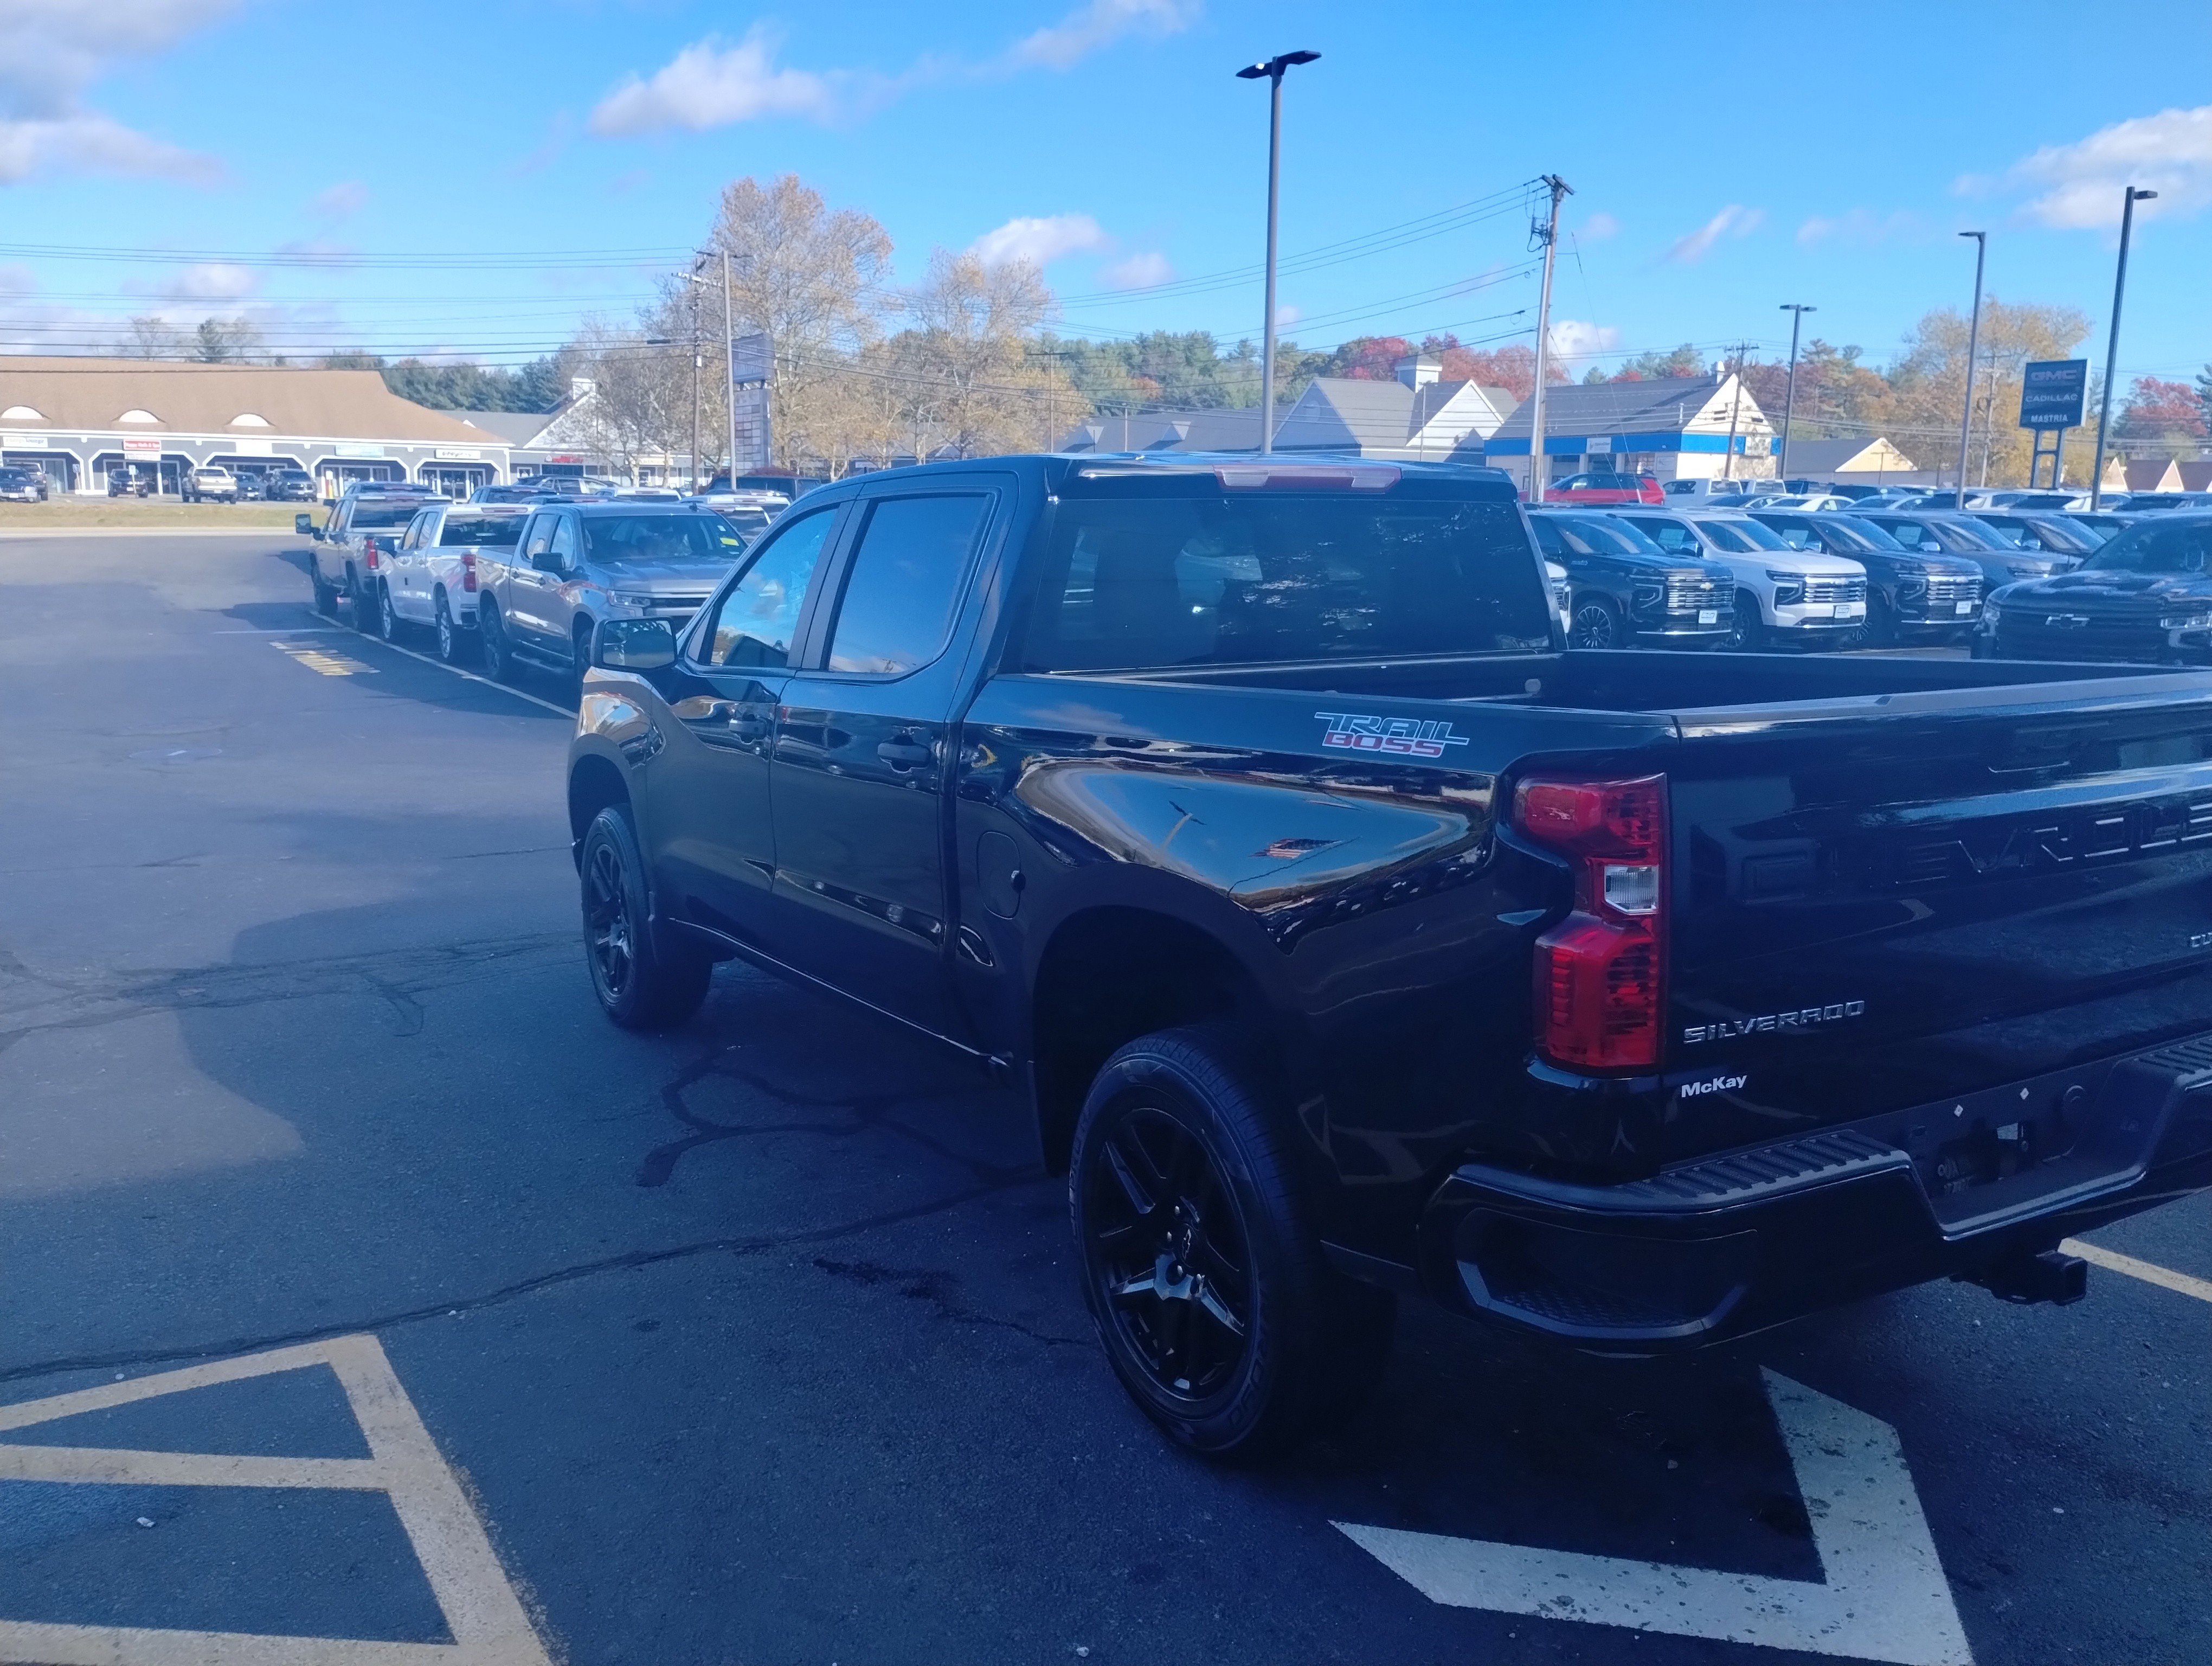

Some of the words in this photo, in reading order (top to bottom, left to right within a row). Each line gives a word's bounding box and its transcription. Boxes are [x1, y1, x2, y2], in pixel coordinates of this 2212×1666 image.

[2031, 370, 2077, 381] GMC
[2025, 393, 2078, 402] CADILLAC
[2030, 414, 2068, 423] MASTRIA
[1314, 712, 1470, 746] TRAIL
[1322, 731, 1446, 758] BOSS
[1683, 1001, 1865, 1044] SILVERADO
[1681, 1075, 1747, 1098] McKay
